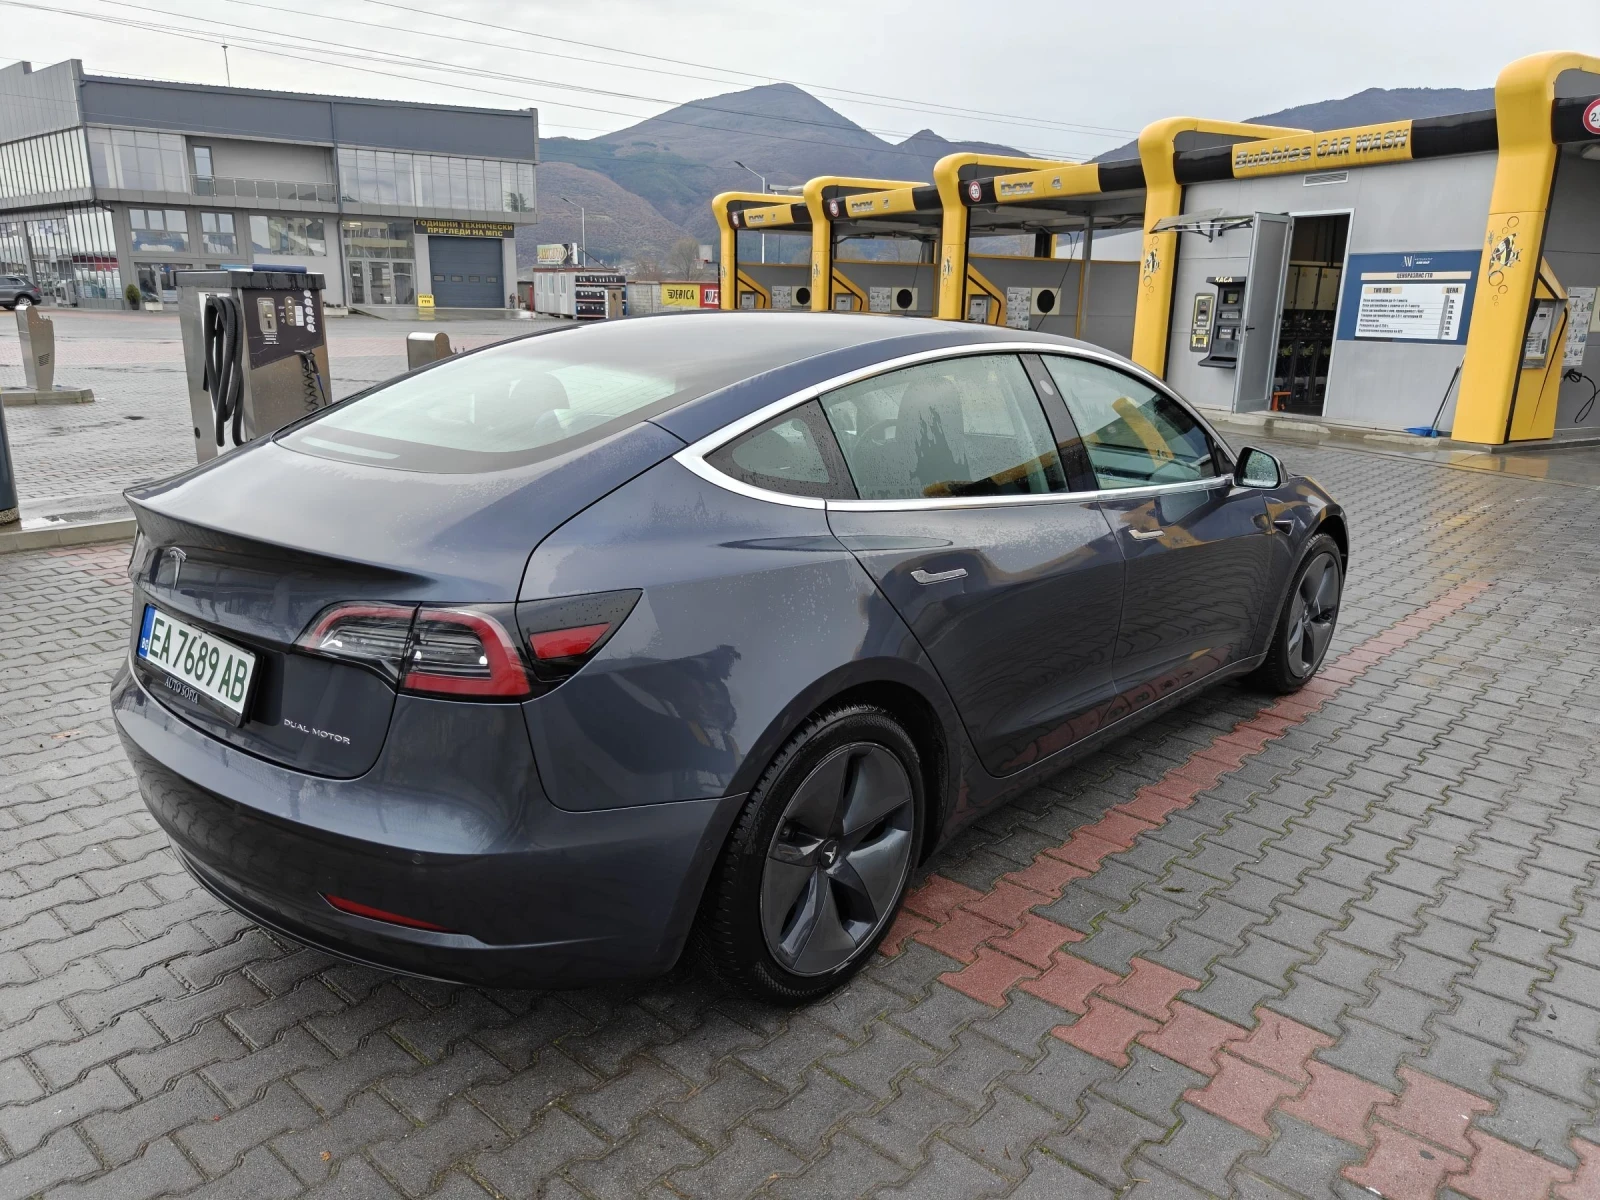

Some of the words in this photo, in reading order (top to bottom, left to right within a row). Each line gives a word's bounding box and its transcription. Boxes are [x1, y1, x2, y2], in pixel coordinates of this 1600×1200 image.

[1234, 145, 1311, 169] Bubbles
[1316, 136, 1351, 159] CAR
[1355, 129, 1409, 154] WASH
[1051, 176, 1062, 190] 4
[415, 219, 458, 228] ГОДИШНИ
[460, 222, 513, 231] ТЕХНИЧЕСКИ
[427, 227, 471, 236] ПРЕГЛЕДИ
[149, 617, 172, 664] EA
[173, 629, 220, 687] 7689
[218, 654, 248, 703] AB
[164, 675, 182, 693] AUTO
[181, 684, 199, 704] SOFIA
[283, 718, 309, 733] DUAL
[312, 728, 351, 745] MOTOR
